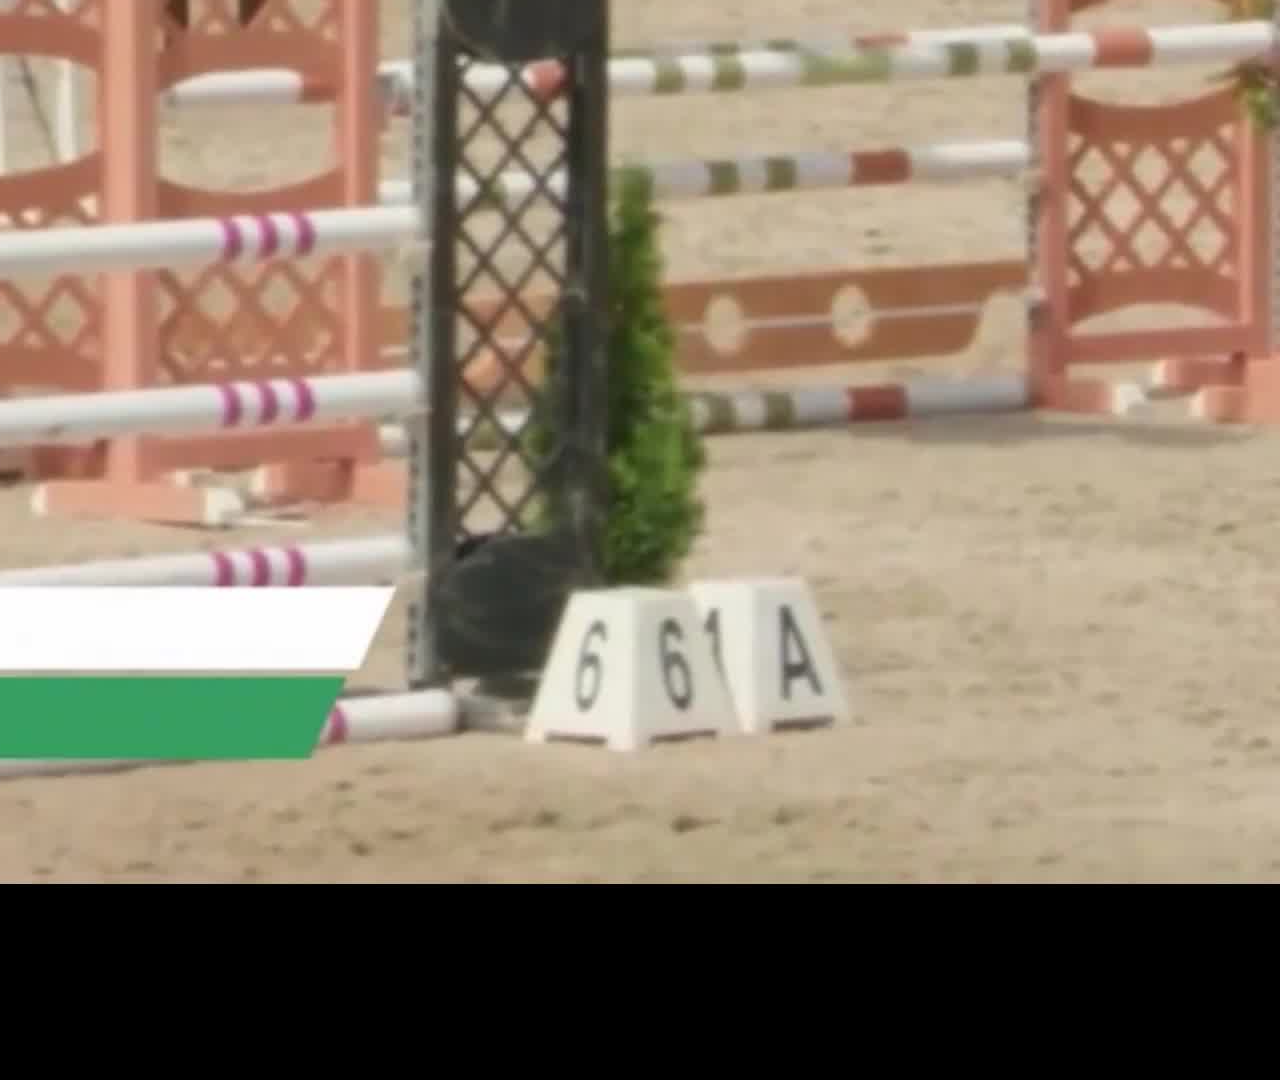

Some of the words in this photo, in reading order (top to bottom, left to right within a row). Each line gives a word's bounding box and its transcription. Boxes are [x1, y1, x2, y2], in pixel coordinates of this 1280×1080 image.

[575, 620, 609, 712] 6
[659, 617, 694, 712] 6
[778, 604, 824, 700] A
